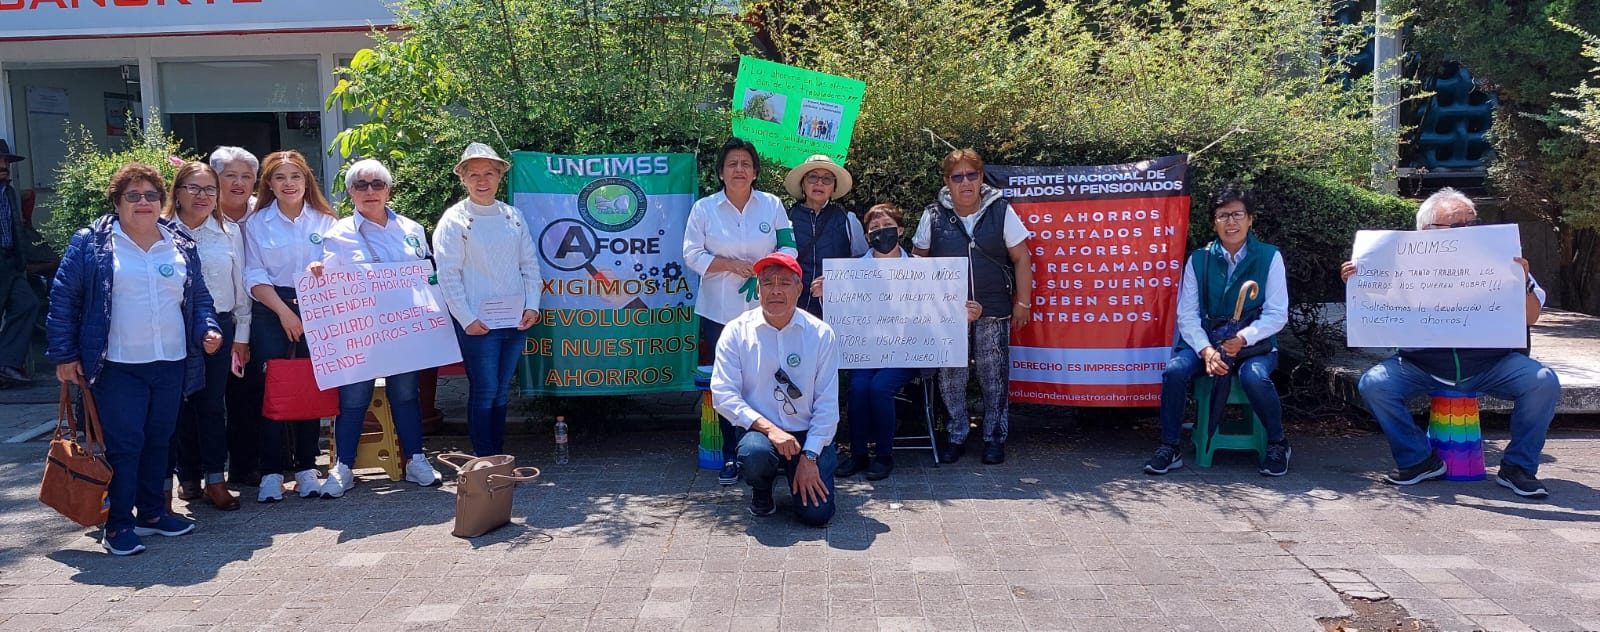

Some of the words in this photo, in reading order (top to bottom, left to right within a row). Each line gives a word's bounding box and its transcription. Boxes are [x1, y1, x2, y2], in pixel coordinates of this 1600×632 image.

[546, 156, 670, 177] UNCIMSS
[1009, 175, 1065, 186] FRENTE
[1067, 172, 1143, 183] NACIONAL
[1146, 170, 1166, 180] DE
[1003, 186, 1065, 197] BILADOS
[1067, 185, 1078, 195] Y
[1080, 180, 1183, 195] PENSIONADOS
[1064, 209, 1160, 223] AHORROS
[1028, 227, 1143, 240] POSITADOS
[1153, 226, 1175, 237] EN
[554, 225, 661, 260] AFORE
[1397, 239, 1459, 255] UNCIMSS
[1055, 245, 1139, 256] AFORES.
[1149, 244, 1167, 254] SI
[1047, 260, 1180, 273] RECLAMADOS
[299, 271, 364, 292] GOBIERNE
[541, 278, 656, 296] XIGIMOS
[665, 276, 690, 294] LA
[1047, 279, 1083, 289] SUS
[1357, 280, 1393, 290] AHORROS
[1399, 282, 1415, 290] NOS
[1421, 282, 1454, 290] QUIEREN
[301, 289, 337, 306] ERNE
[343, 281, 367, 296] LOS
[371, 278, 418, 293] AHORROS
[828, 291, 873, 303] LUCHAMOS
[879, 292, 894, 301] CON
[942, 292, 959, 302] POR
[1036, 295, 1098, 306] DEBEN
[1108, 295, 1144, 305] SER
[1418, 301, 1426, 313] la
[1488, 300, 1503, 312] de
[303, 295, 377, 321] DEFIENDEN
[828, 315, 872, 325] NUESTROS
[1033, 311, 1158, 323] NTREGADOS.
[1361, 315, 1405, 325] nuestros
[308, 315, 374, 345] JUBILADO
[313, 343, 337, 362] SUS
[346, 327, 408, 350] AHORROS
[412, 321, 426, 333] SI
[428, 316, 447, 329] DE
[522, 337, 553, 356] DE
[561, 335, 697, 357] NUESTROS
[876, 335, 918, 346] USURERO
[923, 337, 936, 346] NO
[941, 337, 955, 345] TE
[315, 353, 367, 375] FIENDE
[842, 352, 871, 363] ROBES
[1012, 360, 1063, 371] DERECHO
[1067, 363, 1082, 372] ES
[1084, 362, 1167, 372] IMPRESCRIPTIB
[545, 366, 674, 387] AHORROS
[1008, 389, 1161, 402] voluciondenuestrosahorrosde
